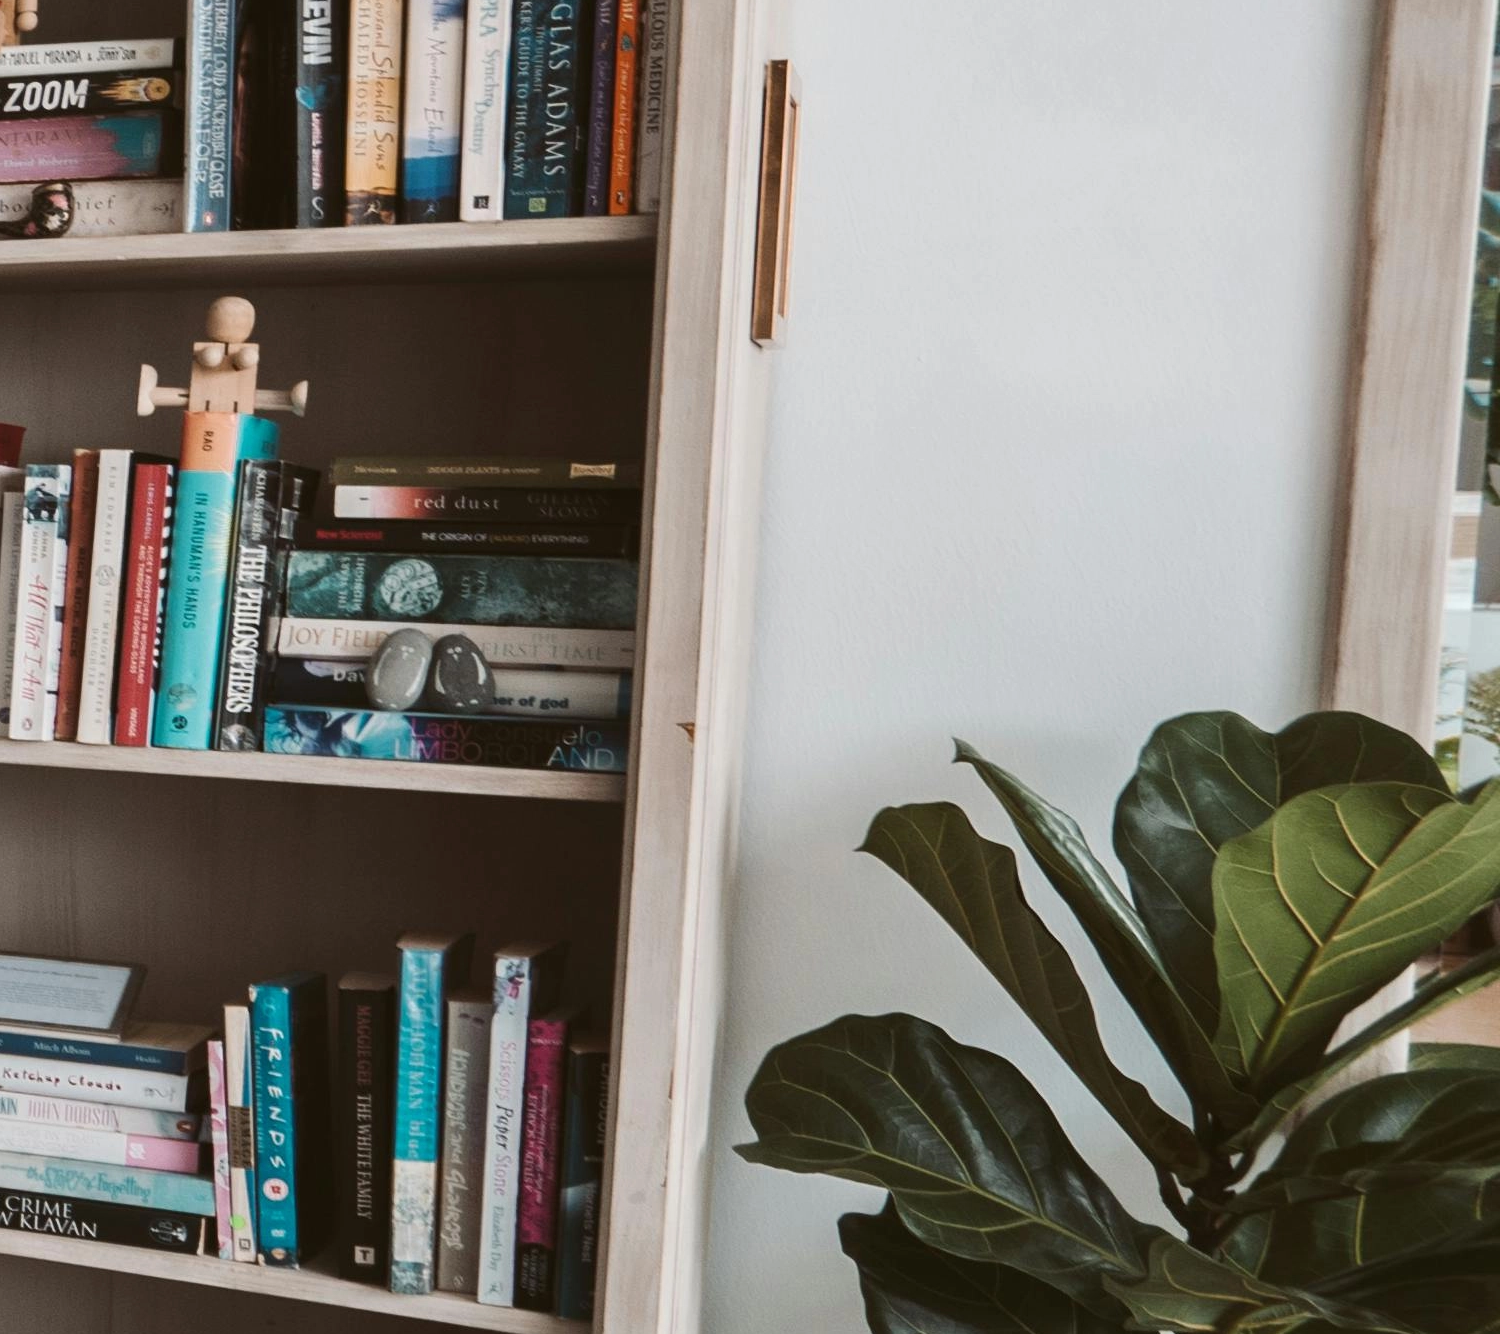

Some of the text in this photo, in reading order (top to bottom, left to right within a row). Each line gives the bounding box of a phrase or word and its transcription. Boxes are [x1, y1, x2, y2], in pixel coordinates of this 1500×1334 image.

[425, 37, 446, 103] Mountains
[516, 37, 531, 76] GUIDE
[4, 79, 89, 112] ZOOM
[370, 51, 393, 123] Splendid
[515, 82, 528, 98] TO
[645, 56, 663, 135] MEDICINE
[354, 74, 367, 157] HOSSEINI
[423, 107, 444, 154] Echoed
[513, 102, 528, 126] THE
[543, 84, 570, 177] ADAMS
[374, 129, 393, 170] Suns
[511, 131, 527, 179] GALAXY
[202, 431, 213, 452] RAO
[414, 493, 500, 509] red dust
[182, 492, 208, 629] IN HANUMAN'S HANDS
[28, 574, 48, 607] All
[24, 613, 46, 650] That
[225, 544, 267, 713] THE PHILOSOPHERS
[21, 666, 40, 702] Am
[356, 1093, 371, 1219] THE WHITE FAMILY
[5, 1195, 72, 1218] CRIME
[20, 1213, 98, 1238] KLAVAN
